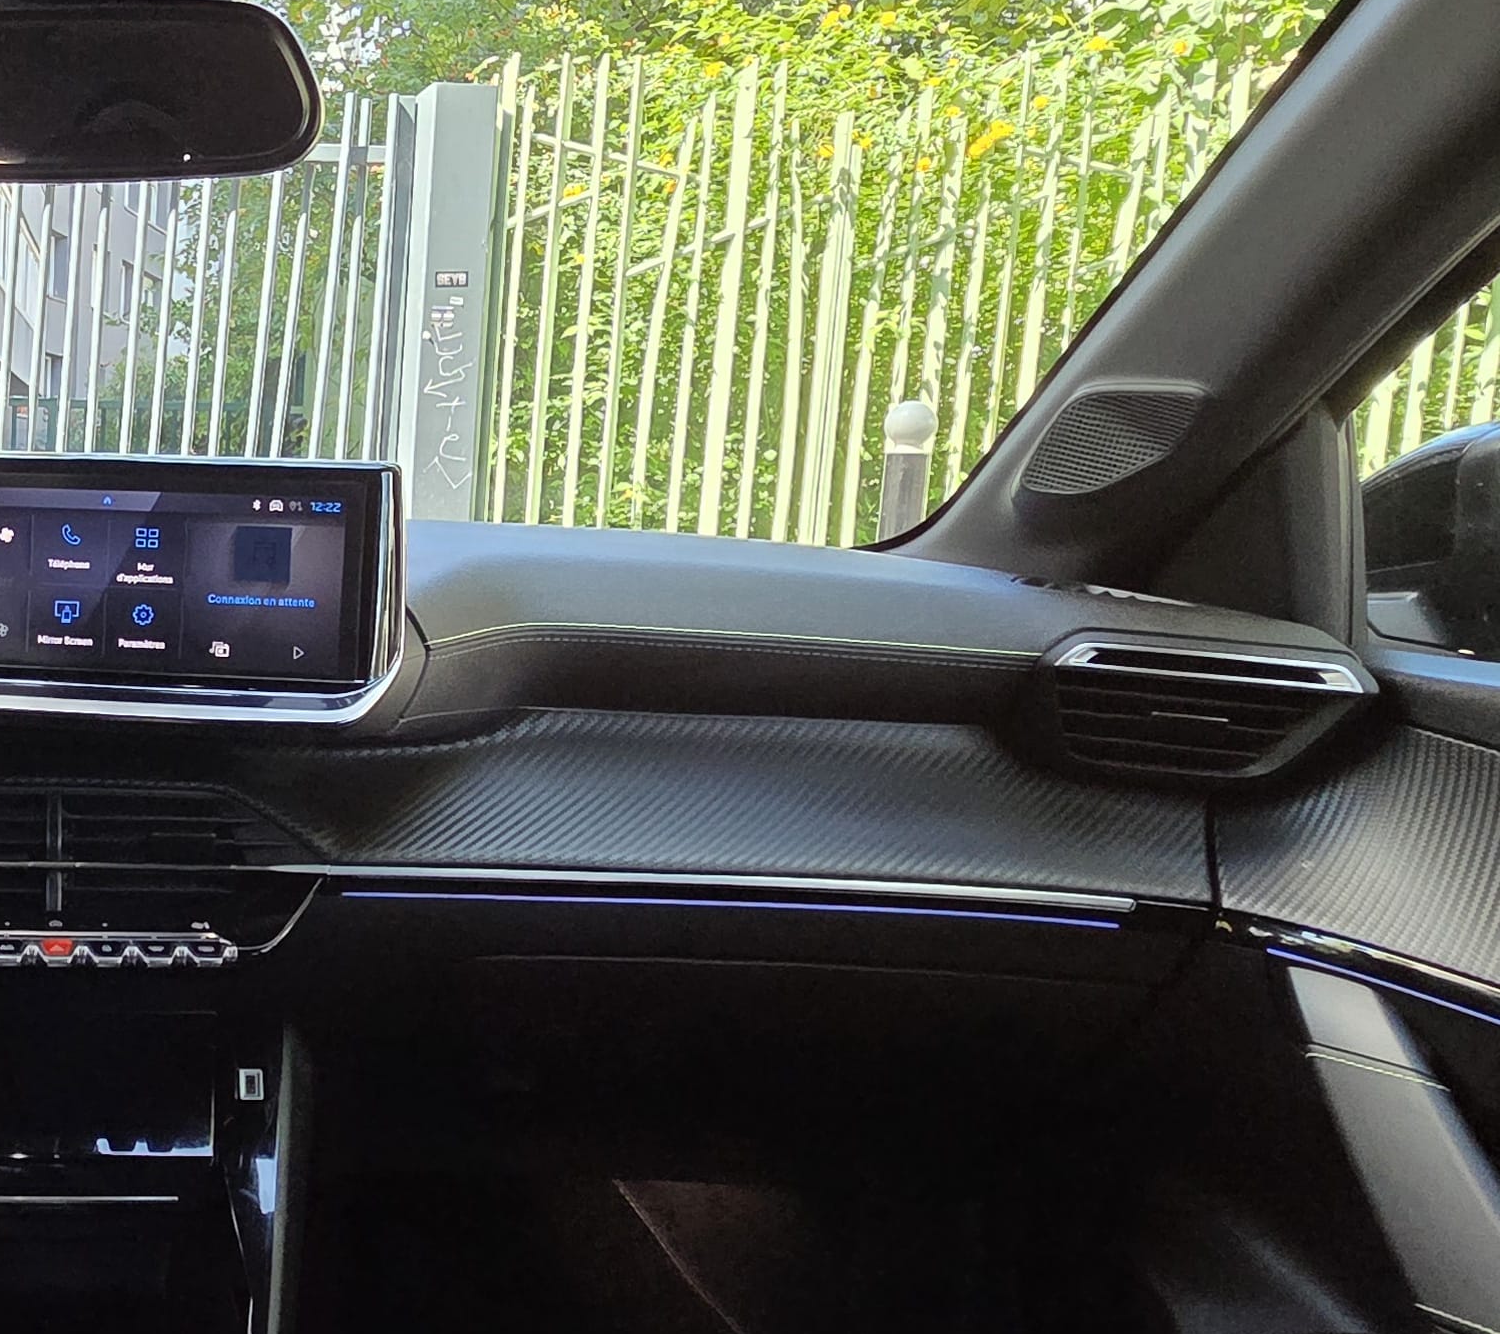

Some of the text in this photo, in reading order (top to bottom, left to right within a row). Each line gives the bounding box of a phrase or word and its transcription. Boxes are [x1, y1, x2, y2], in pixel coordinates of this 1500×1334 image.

[310, 501, 342, 513] 12:22
[207, 593, 262, 605] Connexion
[278, 597, 316, 608] attente
